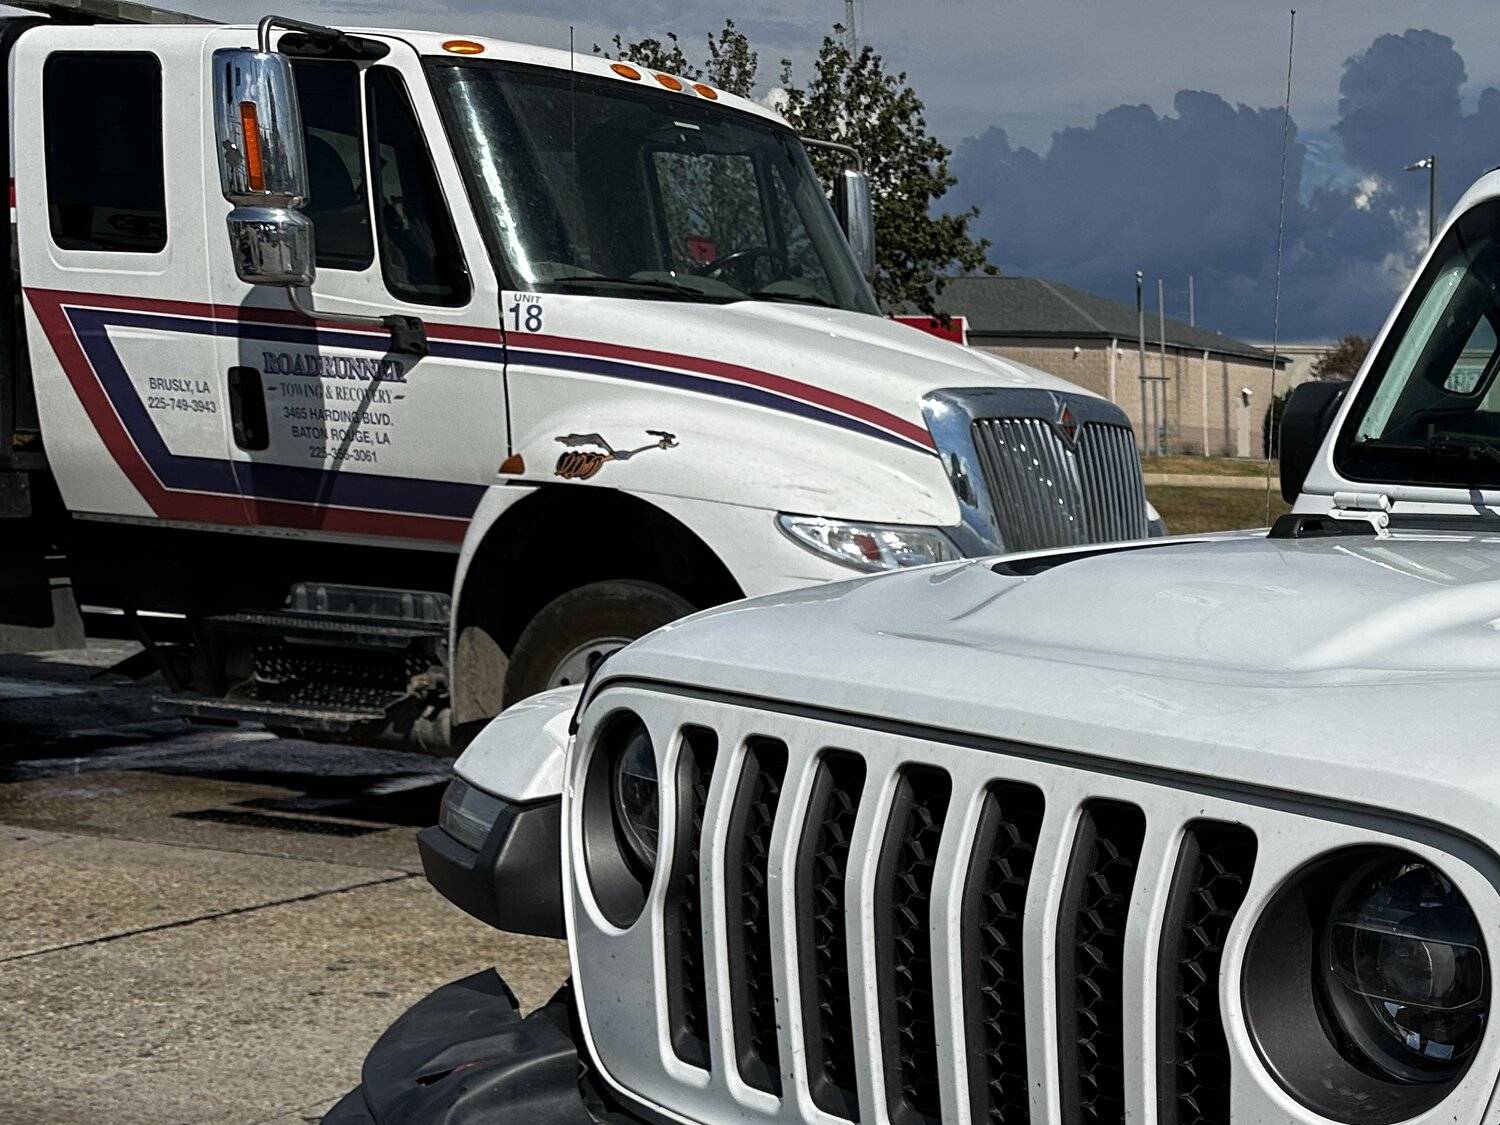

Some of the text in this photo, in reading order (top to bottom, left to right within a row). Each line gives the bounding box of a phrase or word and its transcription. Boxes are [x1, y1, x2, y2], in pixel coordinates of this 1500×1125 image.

[514, 293, 542, 304] UNIT
[509, 303, 543, 332] 18
[262, 351, 407, 383] ROADRUNNER
[149, 377, 211, 395] BRUSLY, LA
[280, 382, 393, 404] TOWING & RECOVERY
[148, 397, 217, 413] 225-749-3943
[310, 408, 360, 424] HARDING
[363, 412, 394, 427] BLVD.
[291, 425, 391, 445] BATON ROUGE, LA
